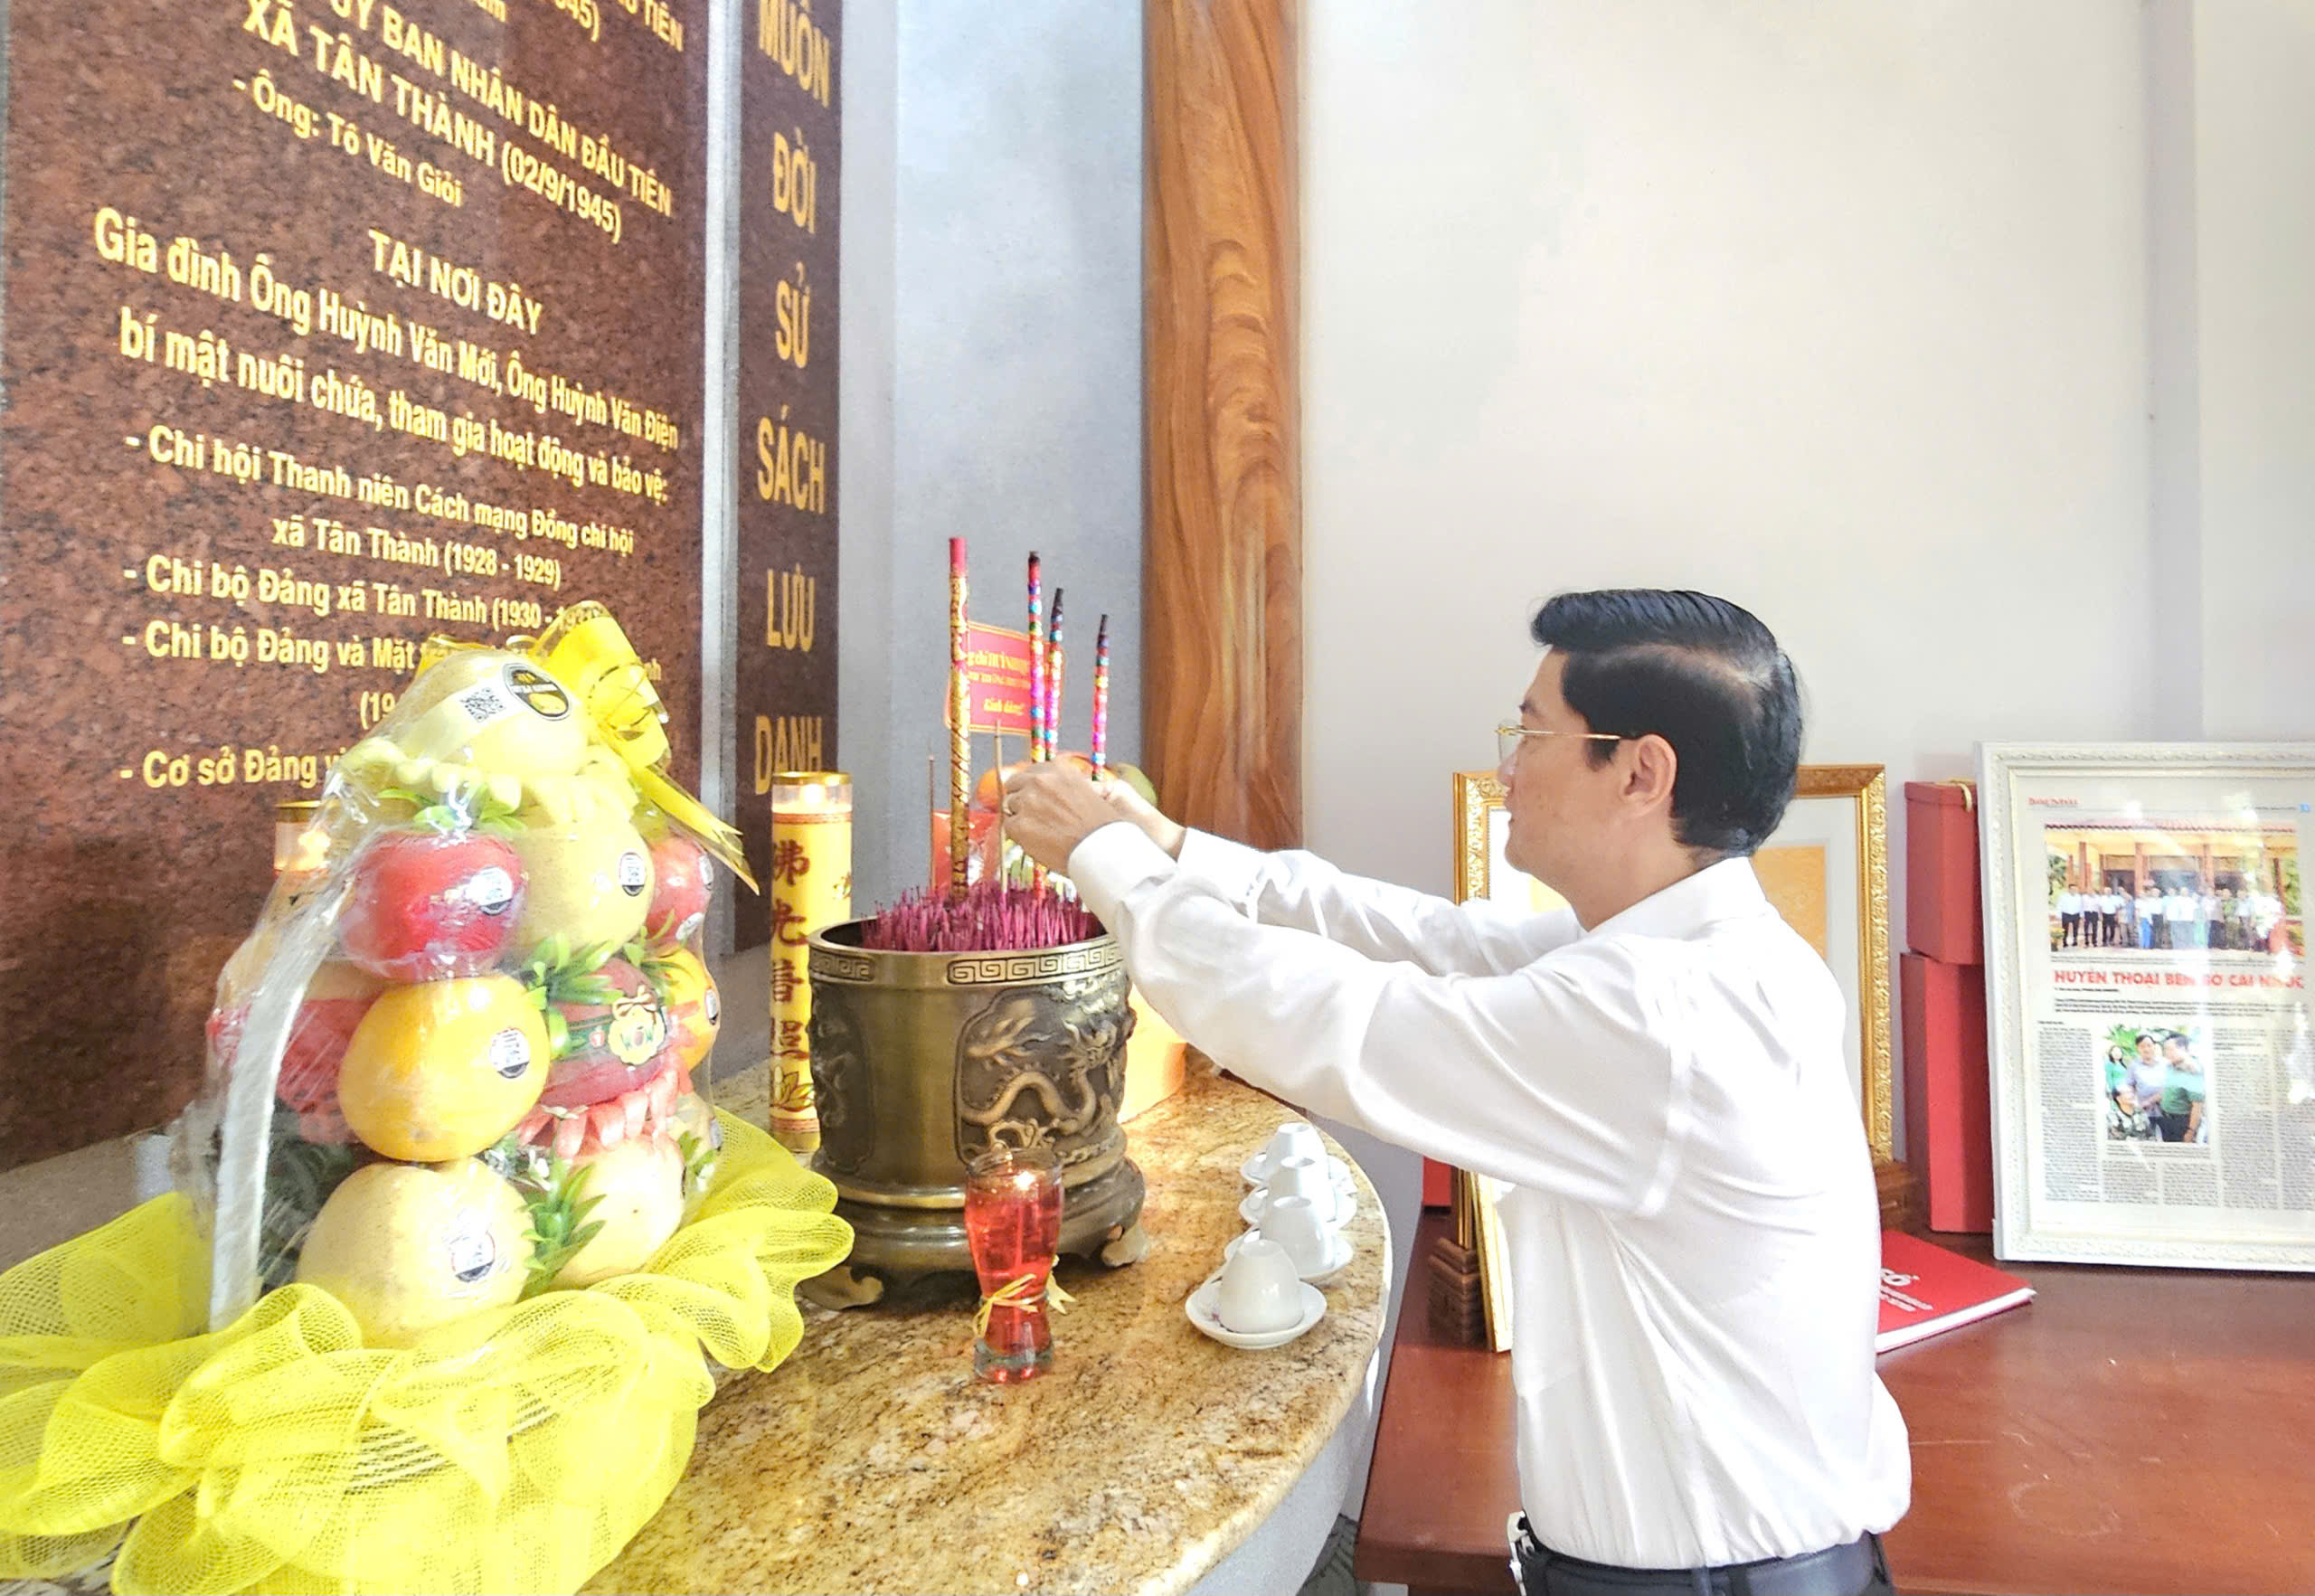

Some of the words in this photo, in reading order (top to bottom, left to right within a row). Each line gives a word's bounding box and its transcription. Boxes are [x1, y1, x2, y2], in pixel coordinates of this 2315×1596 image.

[242, 0, 298, 57] XÃ
[309, 25, 383, 103] TÂN
[391, 73, 495, 166] THÀNH
[501, 140, 621, 245] (02/9/1945)
[252, 69, 320, 138] Ông:
[326, 111, 360, 155] Tô
[366, 132, 411, 184] Văn
[383, 5, 445, 77] BAN
[451, 50, 523, 126] NHÂN
[528, 100, 577, 159] DÂN
[581, 134, 625, 187] ĐẦU
[628, 164, 672, 217] TIÊN
[773, 127, 816, 234] ĐỜI
[95, 206, 157, 273] Gia
[166, 237, 241, 302] đình
[250, 252, 311, 335] Ông
[319, 288, 402, 356] Huỳnh
[408, 321, 453, 373] Văn
[458, 340, 503, 397] Mới,
[506, 350, 546, 414] Ông
[551, 375, 607, 426] Huỳnh
[610, 396, 643, 437] Văn
[368, 228, 422, 288] TẠI
[430, 256, 480, 310] NƠI
[487, 282, 543, 335] ĐÂY
[775, 261, 810, 369] SỬ
[120, 306, 158, 363] bí
[165, 329, 231, 388] mật
[238, 354, 304, 402] nuôi
[310, 369, 383, 432] chứa,
[388, 391, 448, 442] tham
[452, 411, 485, 457] gia
[490, 419, 535, 470] hoạt
[538, 435, 585, 487] động
[588, 450, 609, 486] và
[611, 456, 642, 496] bảo
[645, 467, 667, 505] vệ:
[757, 404, 825, 514] SÁCH
[148, 424, 205, 469] Chi
[213, 438, 260, 484] hội
[268, 449, 352, 498] Thanh
[358, 472, 410, 510] niên
[414, 484, 470, 522] Cách
[474, 502, 528, 540] mạng
[532, 508, 578, 550] Đồng
[609, 526, 634, 557] hội
[146, 553, 203, 596] Chi
[211, 562, 250, 607] bộ
[258, 567, 330, 617] Đảng
[337, 580, 366, 611] xã
[373, 582, 416, 616] Tân
[421, 589, 487, 624] Thành
[492, 597, 542, 632] (1930
[271, 515, 305, 548] xã
[312, 517, 361, 556] Tân
[366, 527, 439, 567] Thành
[444, 540, 497, 577] (1928
[514, 553, 562, 591] 1929)
[145, 619, 202, 658] Chi
[210, 625, 249, 667] bộ
[257, 627, 329, 674] Đảng
[336, 635, 364, 667] và
[373, 637, 415, 675] Mặt
[767, 562, 815, 652] LƯU
[142, 750, 189, 788] Cơ
[197, 746, 236, 786] sở
[244, 745, 317, 789] Đảng
[755, 715, 822, 795] DANH
